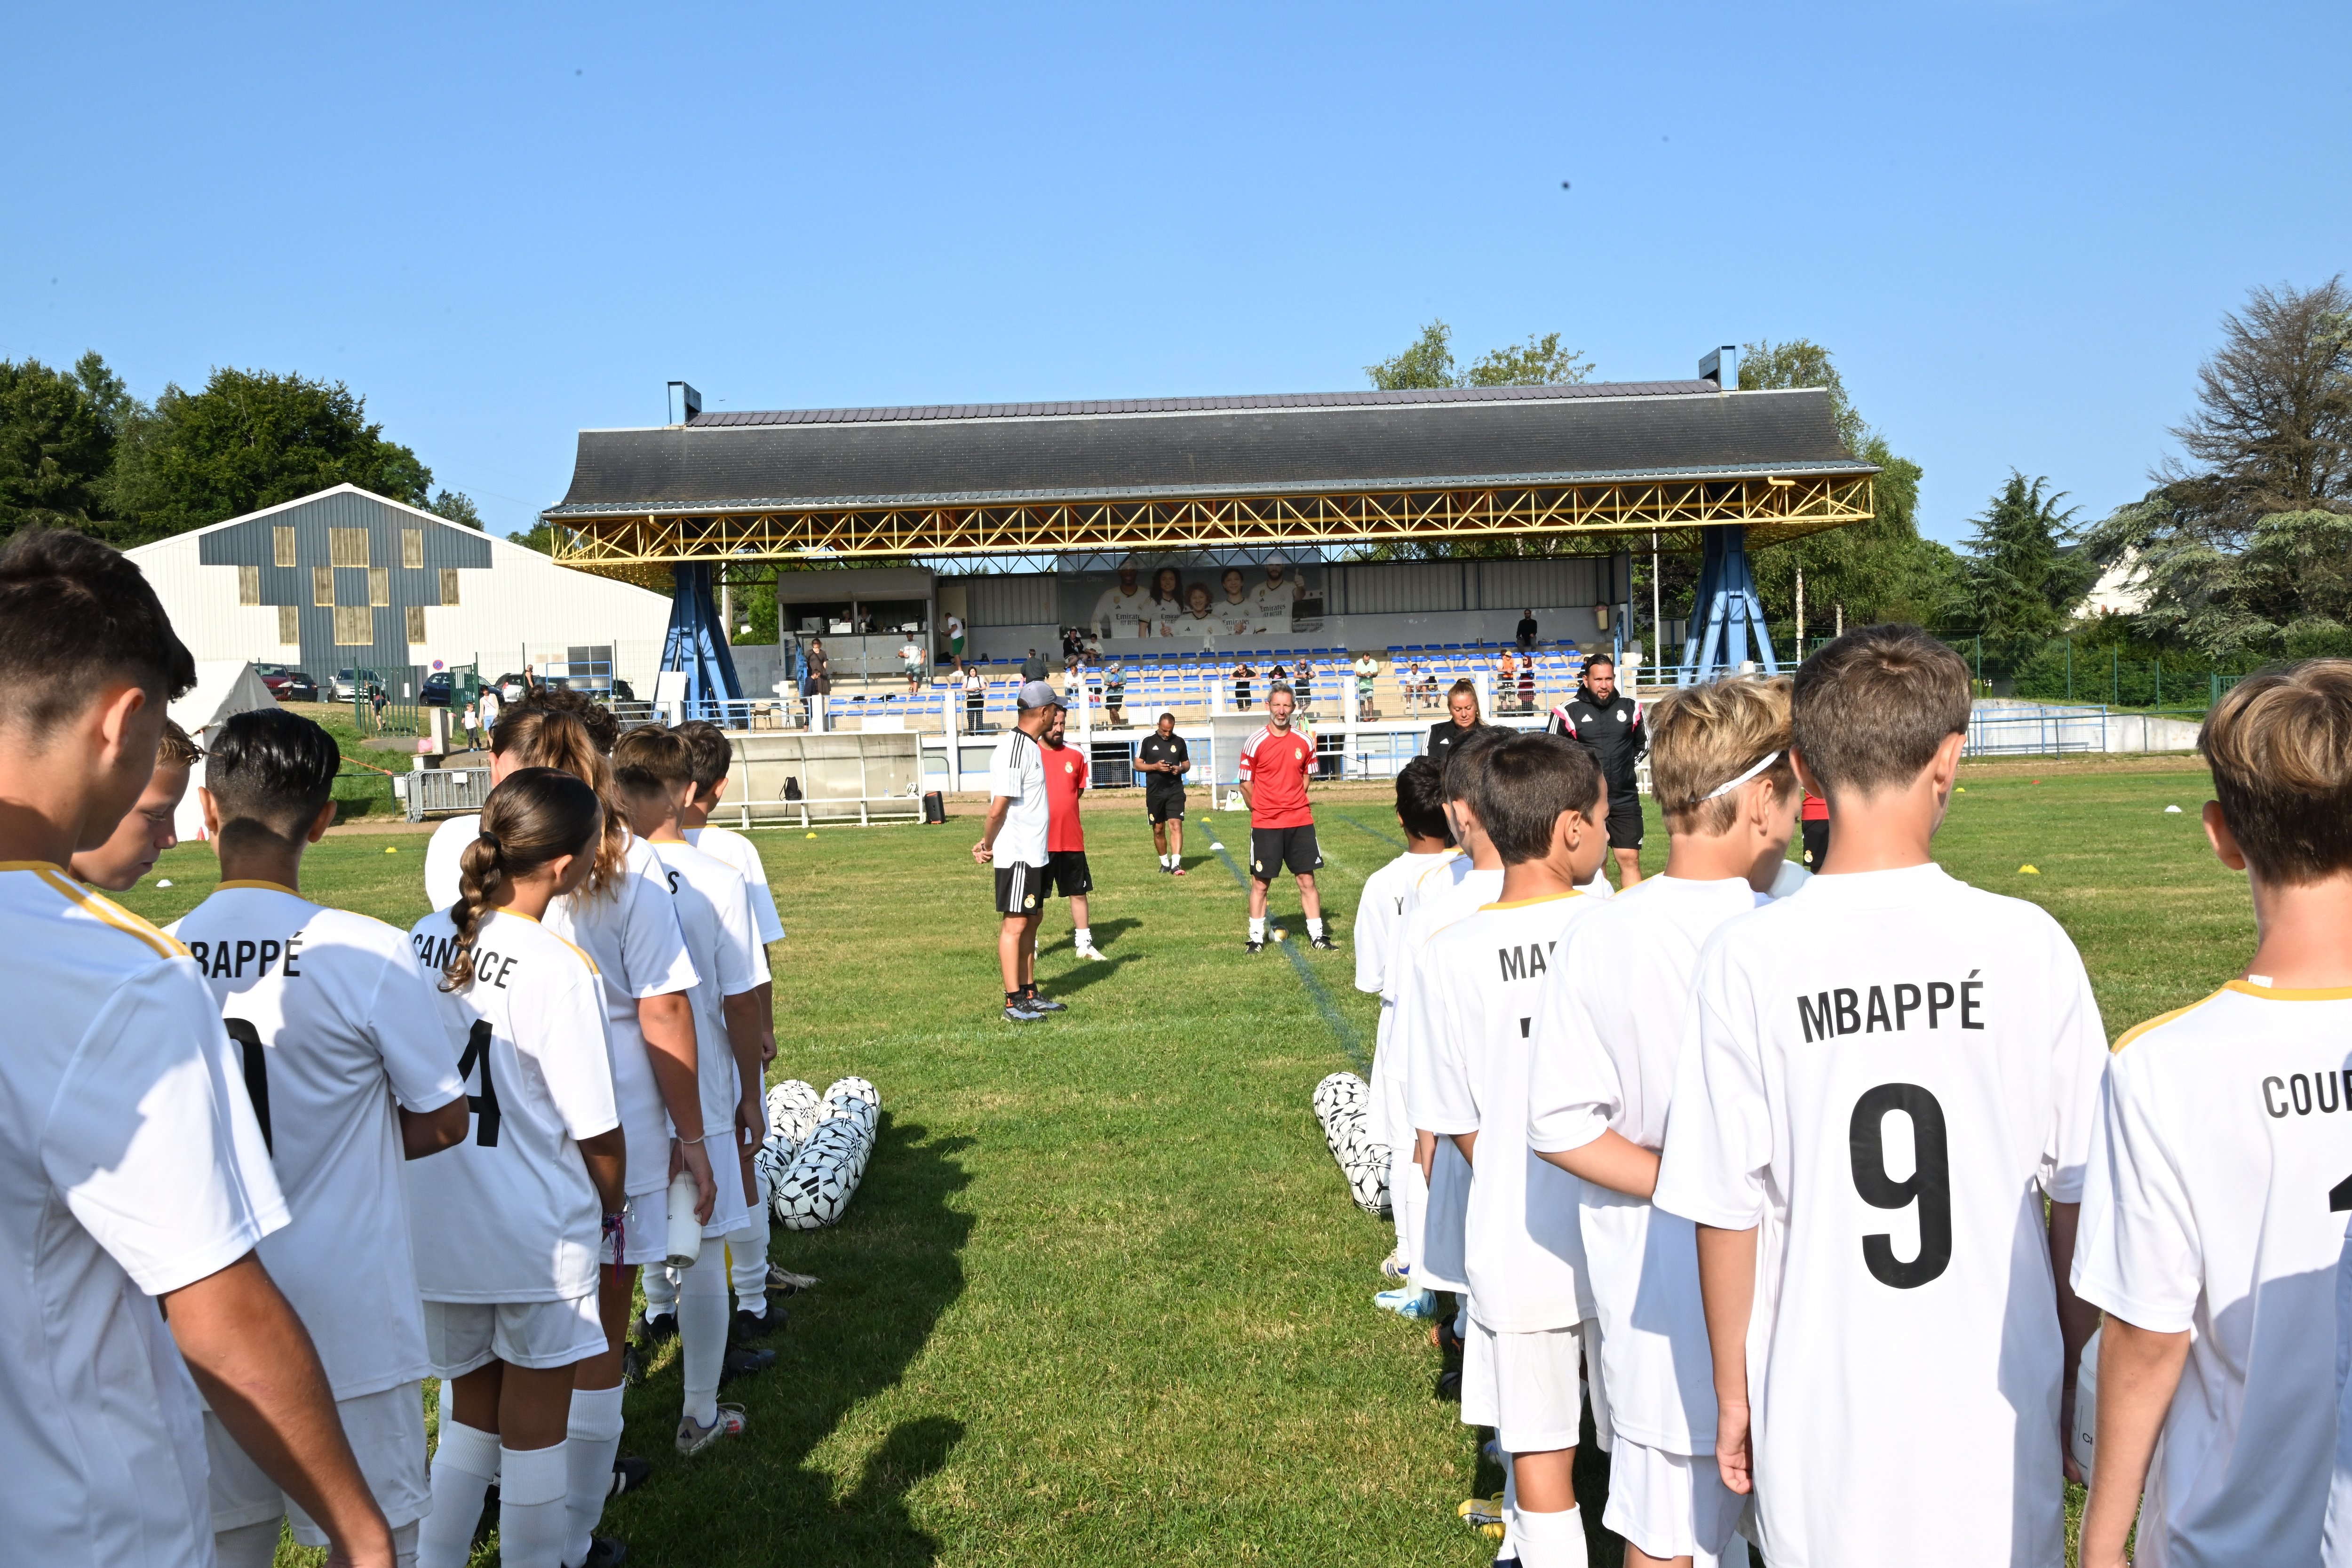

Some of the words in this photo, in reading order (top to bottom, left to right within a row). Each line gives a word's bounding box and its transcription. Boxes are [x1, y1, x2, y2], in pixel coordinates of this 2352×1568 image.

[182, 931, 303, 979] BAPPÉ
[1499, 941, 1557, 981] MA
[1797, 969, 1984, 1043] MBAPPÉ
[457, 1018, 501, 1147] 4
[1849, 1082, 1952, 1289] 9
